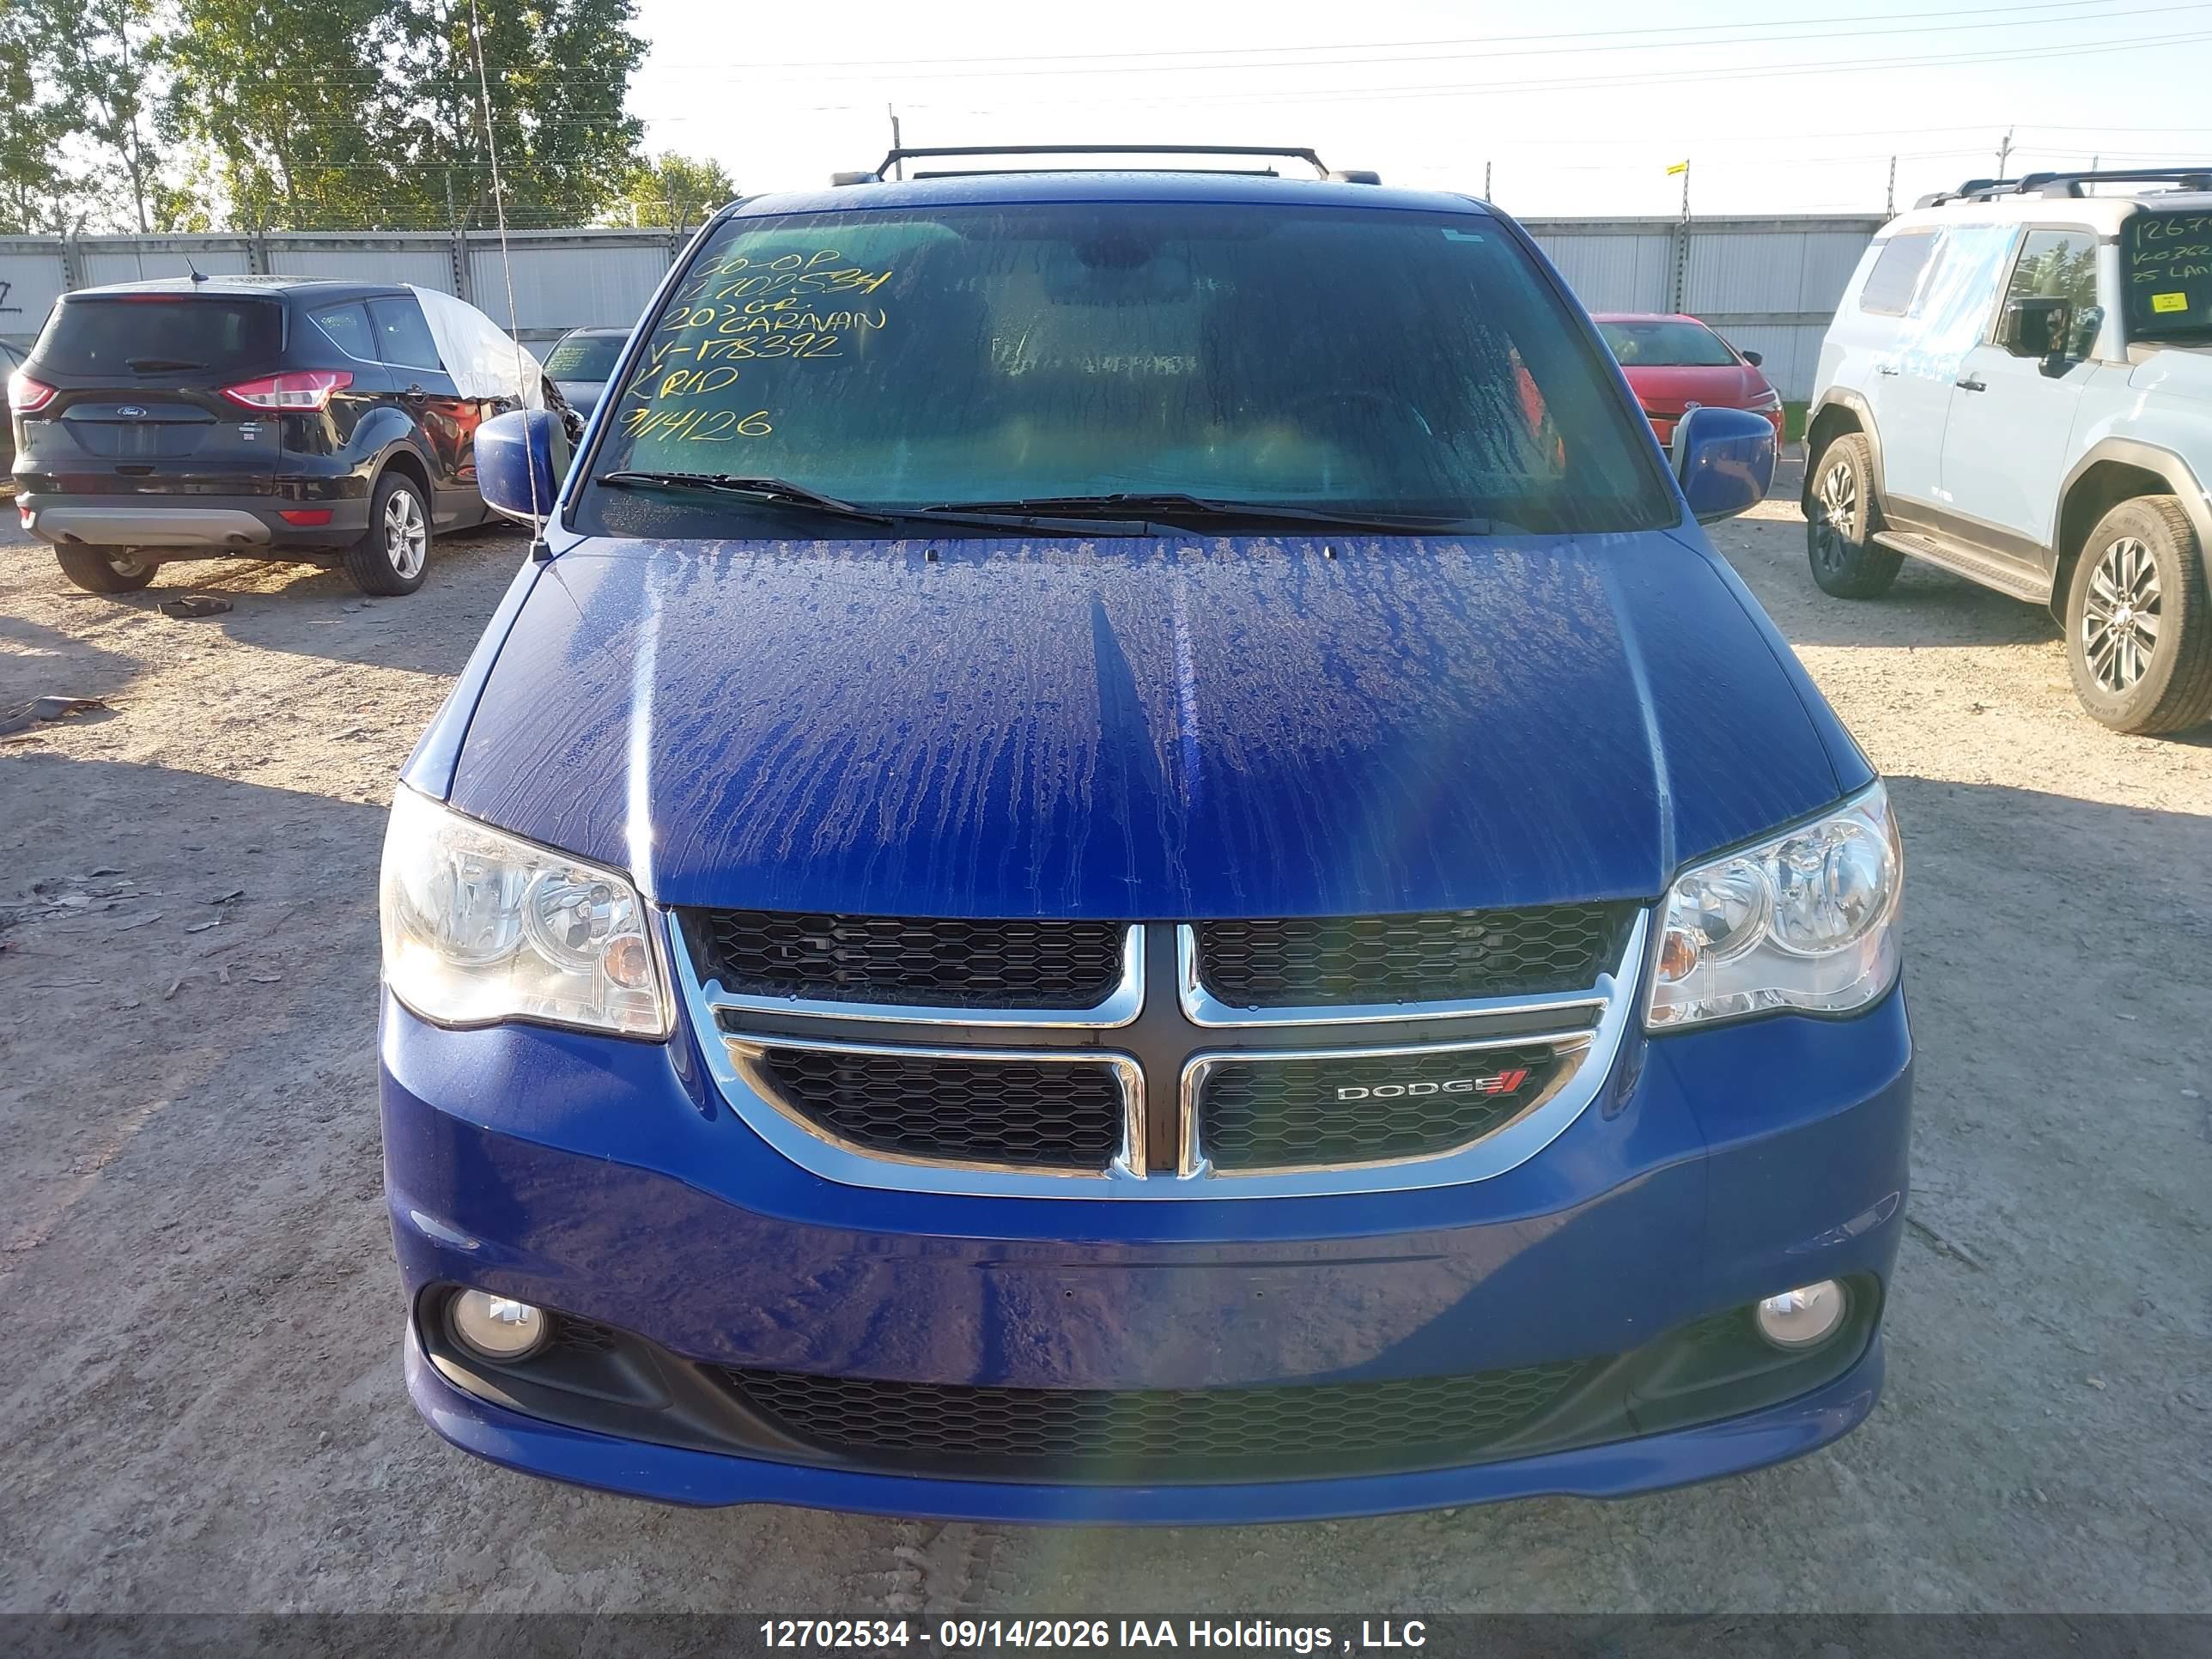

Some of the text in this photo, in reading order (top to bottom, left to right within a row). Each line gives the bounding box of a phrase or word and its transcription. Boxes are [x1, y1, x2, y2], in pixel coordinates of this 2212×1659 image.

[2136, 217, 2212, 247] 1267
[672, 268, 893, 306] 12702534
[2131, 269, 2160, 283] 25
[663, 307, 715, 332] 20
[718, 308, 886, 333] CARAVAN
[122, 407, 139, 416] Ford
[1337, 1077, 1504, 1100] DODGE
